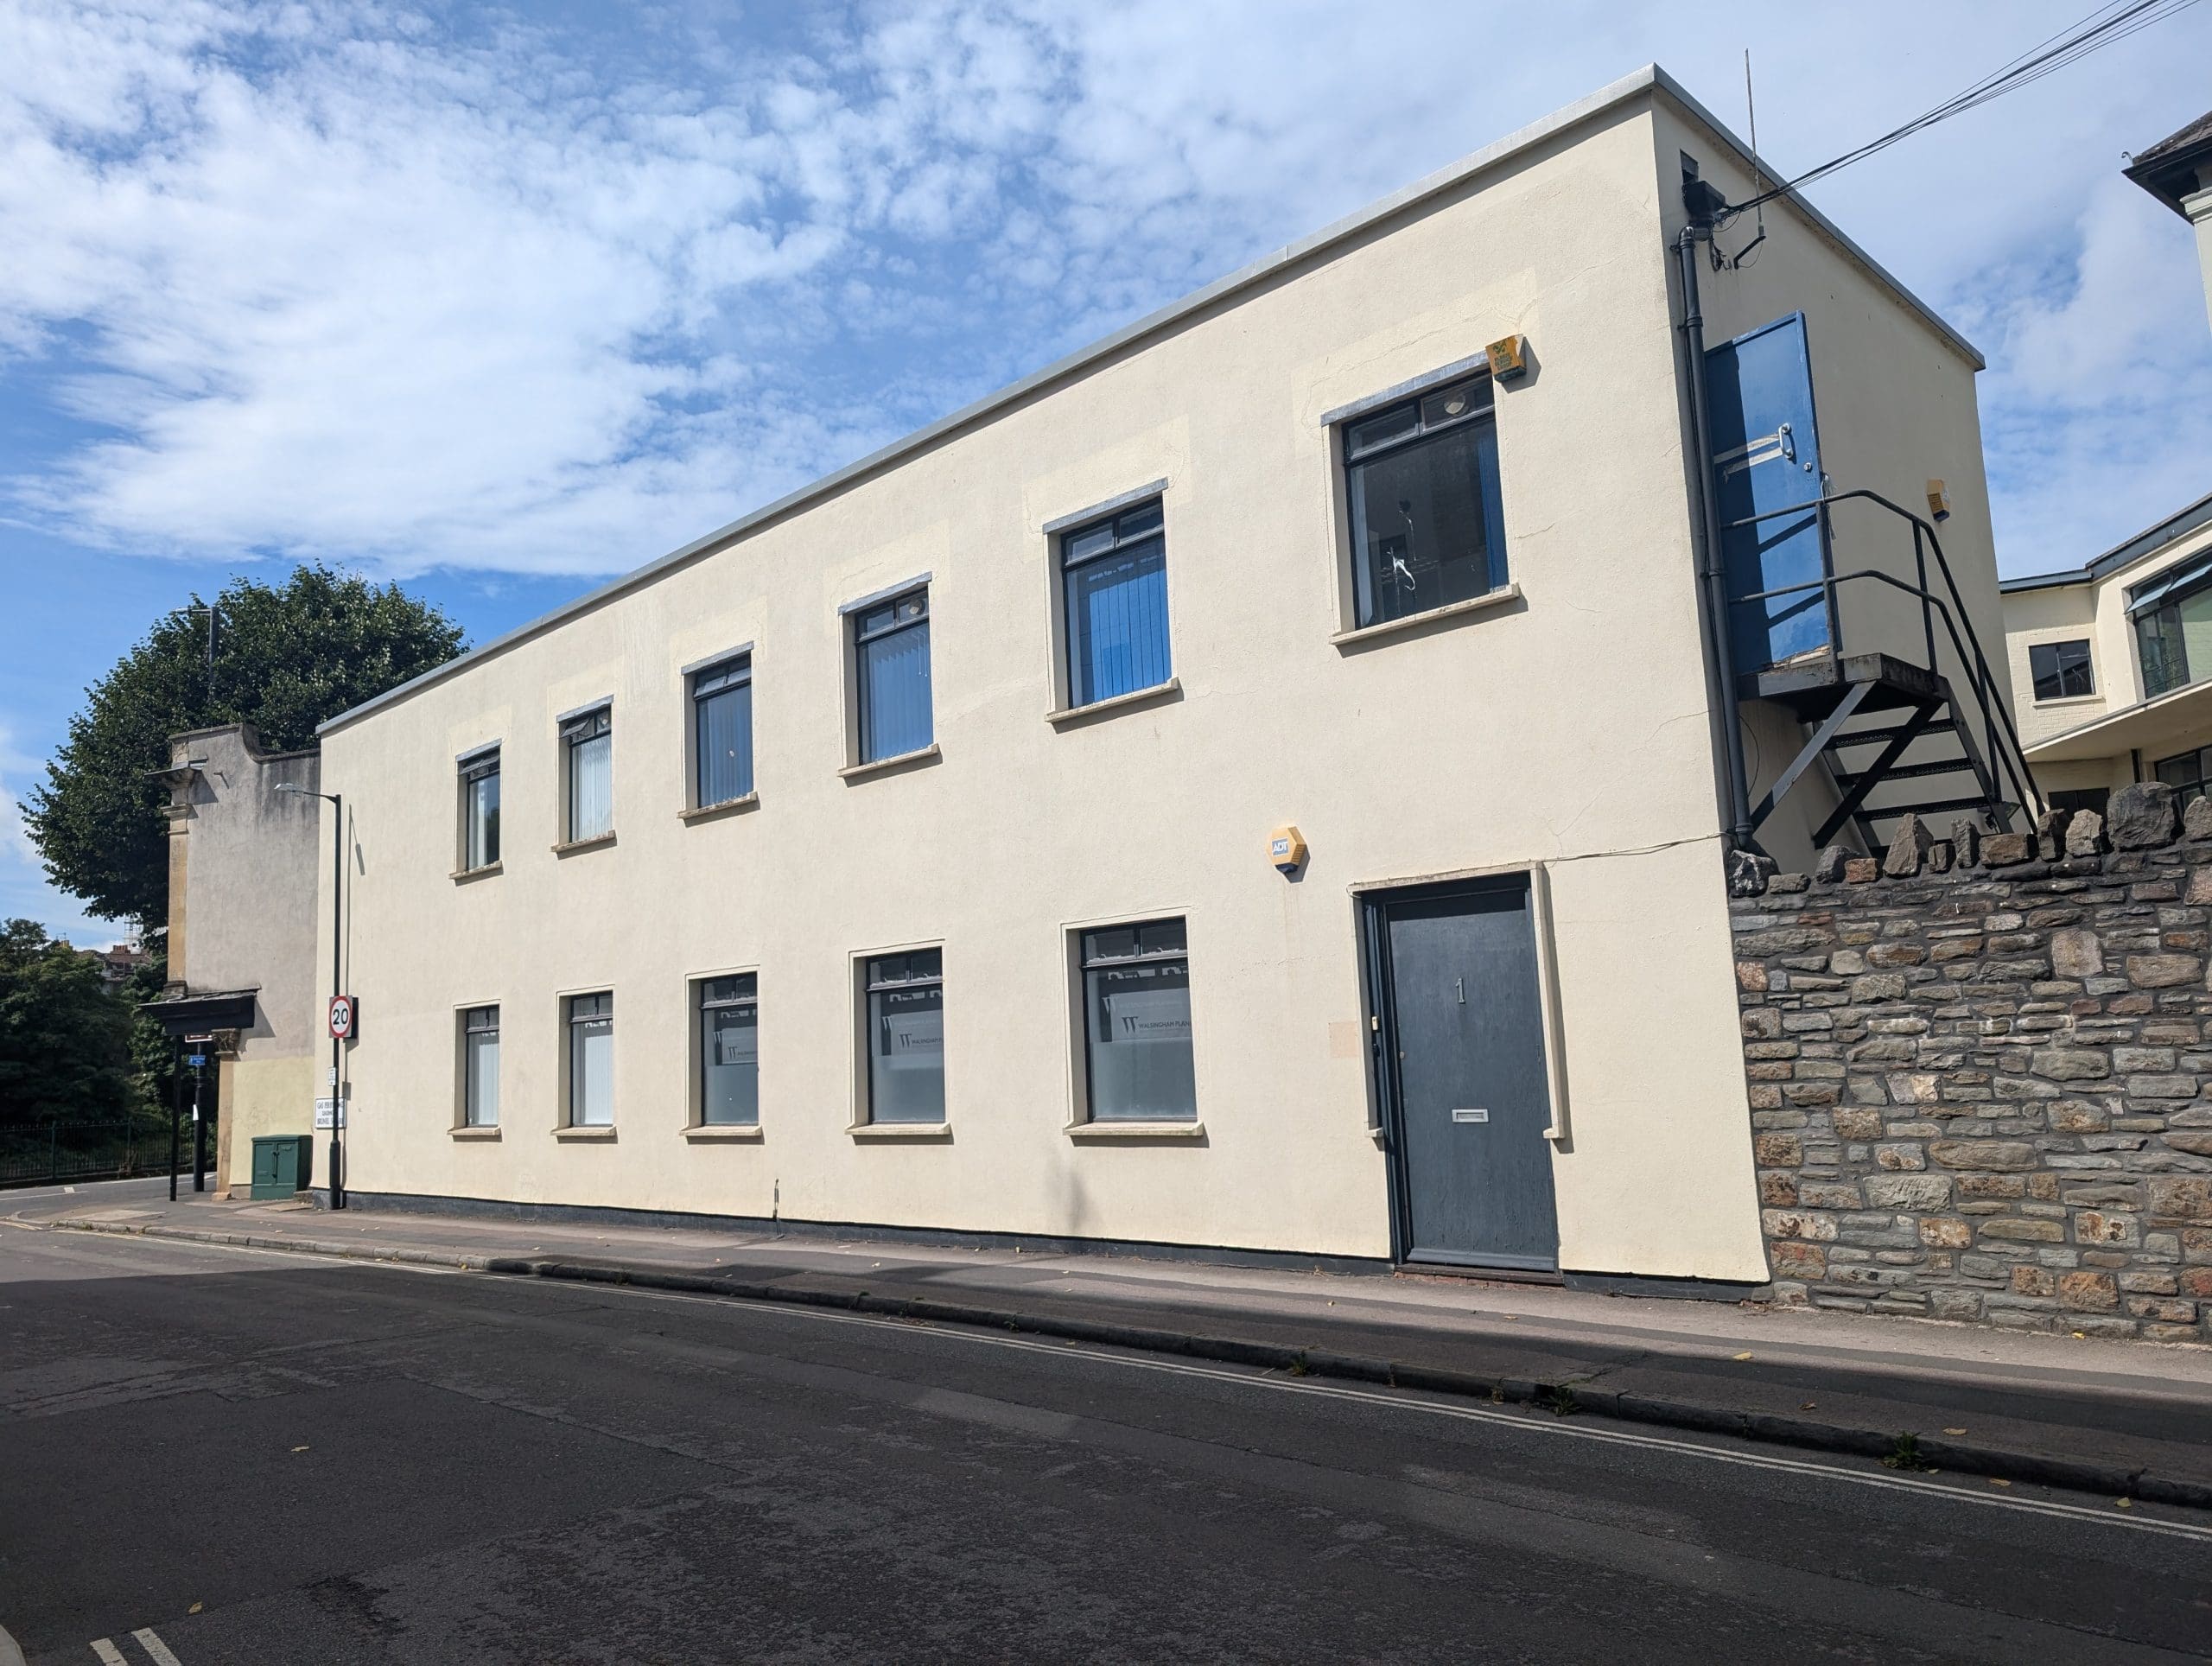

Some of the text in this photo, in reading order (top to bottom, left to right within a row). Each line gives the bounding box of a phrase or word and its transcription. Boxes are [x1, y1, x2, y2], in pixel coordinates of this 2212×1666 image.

[1273, 841, 1288, 852] ADT
[1456, 977, 1465, 1003] 1
[333, 1008, 349, 1026] 20
